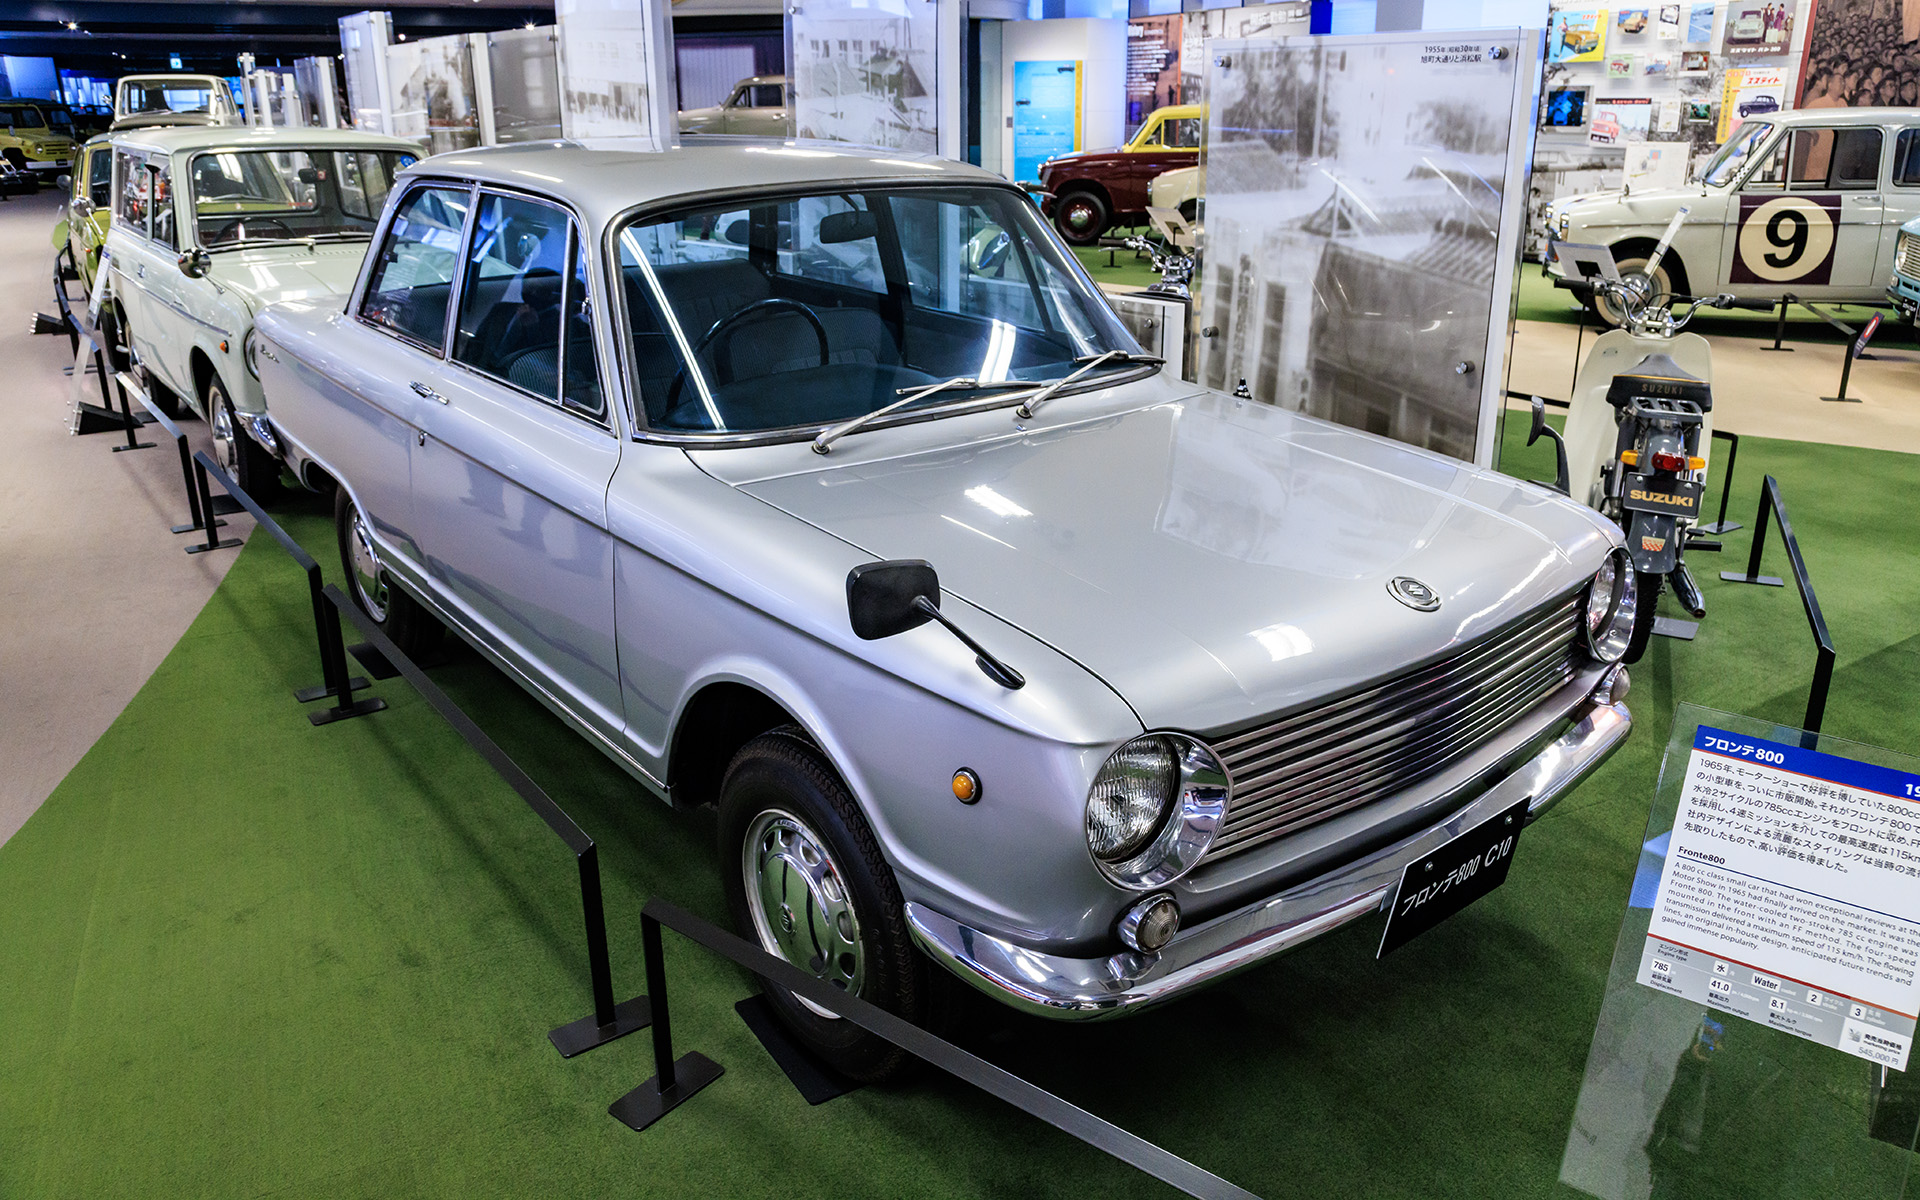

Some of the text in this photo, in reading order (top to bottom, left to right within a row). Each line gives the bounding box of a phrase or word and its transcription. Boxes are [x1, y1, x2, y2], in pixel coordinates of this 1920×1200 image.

[1764, 210, 1808, 268] 9
[1642, 383, 1683, 395] SUZUKI
[1630, 489, 1693, 507] SUZUKI
[1705, 736, 1784, 764] フロンテ800
[1678, 845, 1725, 864] Fronte800
[1401, 836, 1513, 916] フロンテ800 C10
[1672, 870, 1694, 881] Motor
[1696, 876, 1716, 888] Show
[1728, 886, 1745, 896] 1965
[1747, 892, 1762, 901] had
[1764, 896, 1787, 909] finally
[1788, 905, 1817, 917] arrived
[1831, 917, 1845, 925] the
[1888, 934, 1904, 942] was
[1681, 863, 1695, 872] 800
[1706, 871, 1724, 881] class
[1726, 877, 1746, 886] small
[1761, 886, 1777, 896] that
[1778, 891, 1794, 900] had
[1796, 897, 1813, 906] won
[1814, 902, 1862, 920] exceptional
[1864, 916, 1896, 930] reviews
[1661, 915, 1686, 926] gained
[1686, 922, 1719, 937] immense
[1667, 889, 1705, 904] mounted
[1717, 903, 1731, 911] the
[1733, 906, 1754, 919] front
[1757, 915, 1776, 925] with
[1846, 939, 1861, 950] The
[1864, 945, 1915, 966] four-speed
[1670, 878, 1695, 891] Fronte
[1717, 892, 1731, 902] The
[1733, 899, 1787, 918] water-cooled
[1789, 914, 1835, 932] two-stroke
[1838, 927, 1853, 937] 785
[1867, 938, 1898, 951] engine
[1901, 948, 1918, 957] was
[1666, 897, 1710, 915] transmission
[1711, 911, 1745, 925] delivered
[1752, 924, 1790, 938] maximum
[1791, 935, 1815, 946] speed
[1827, 944, 1840, 954] 115
[1867, 956, 1881, 966] The
[1883, 961, 1914, 977] flowing
[1695, 916, 1724, 928] original
[1725, 924, 1759, 939] in-house
[1790, 945, 1837, 963] anticipated
[1838, 958, 1864, 971] future
[1866, 967, 1892, 980] trends
[1894, 977, 1912, 986] and
[1654, 961, 1668, 971] 785
[1717, 964, 1725, 972] 水
[1711, 980, 1729, 991] 41.0
[1754, 976, 1777, 989] Water
[1771, 1000, 1783, 1008] 8.1
[1858, 1047, 1889, 1062] 545,000
